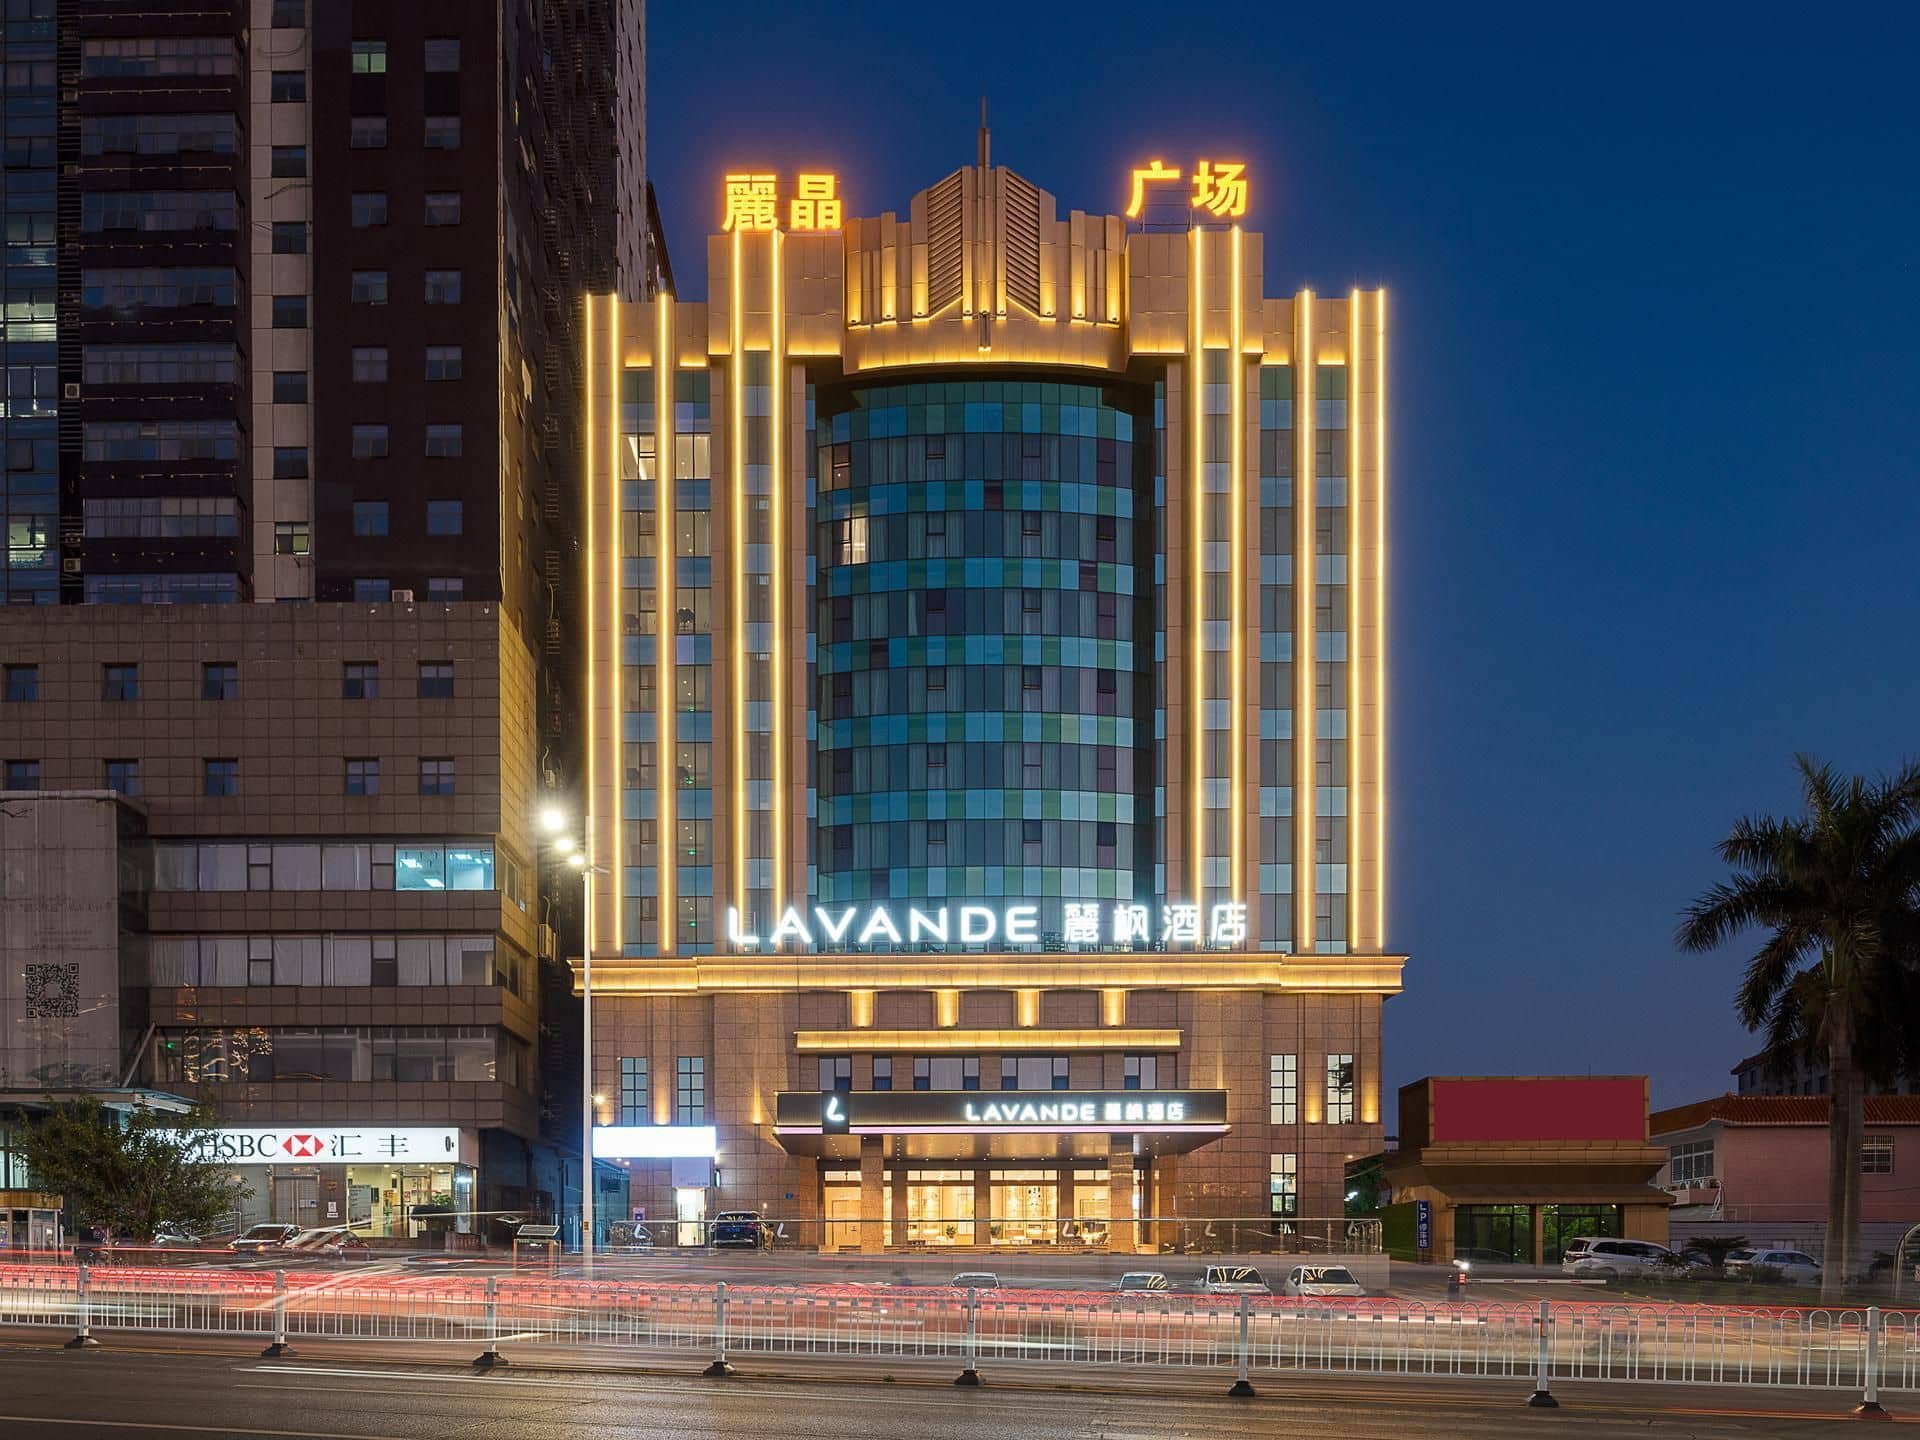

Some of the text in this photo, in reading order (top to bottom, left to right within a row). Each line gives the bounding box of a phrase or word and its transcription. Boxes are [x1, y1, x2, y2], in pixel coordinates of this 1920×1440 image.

[722, 159, 1248, 231] 麗晶 广场
[728, 903, 1248, 944] LAVANDE 麗枫酒店
[965, 1104, 1096, 1121] LAVANDE
[198, 1134, 409, 1158] HSBC 汇丰
